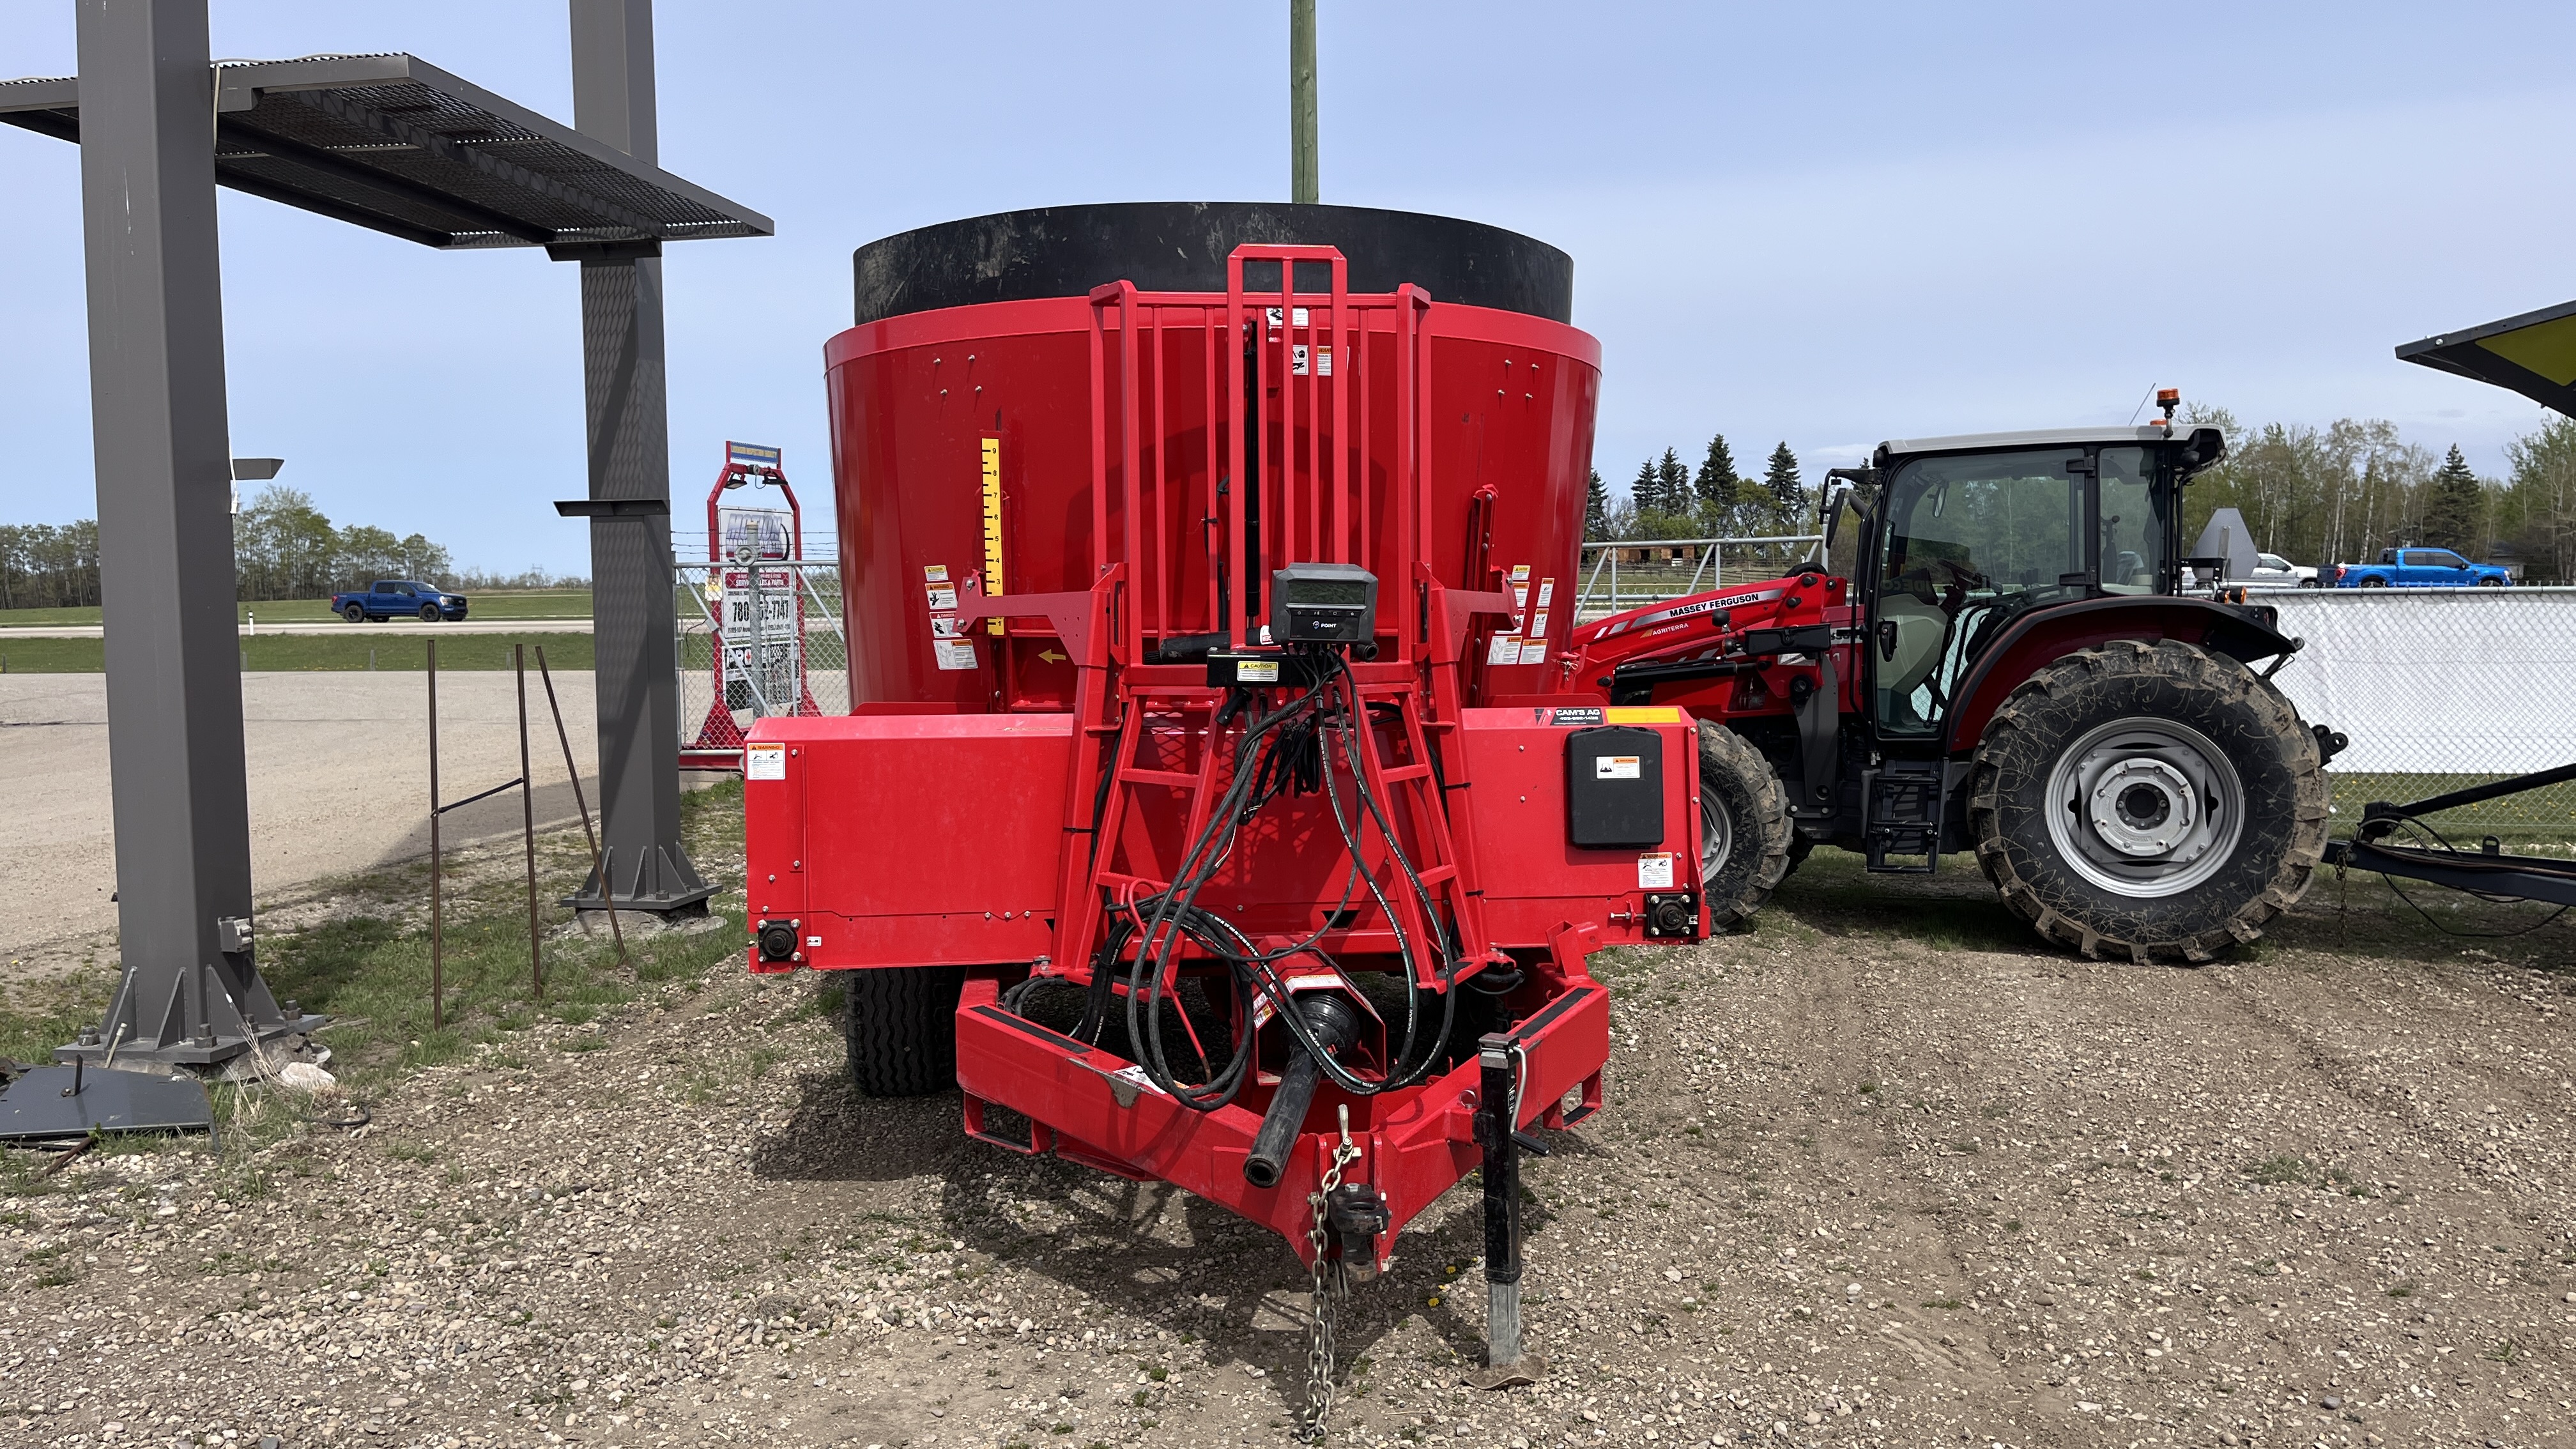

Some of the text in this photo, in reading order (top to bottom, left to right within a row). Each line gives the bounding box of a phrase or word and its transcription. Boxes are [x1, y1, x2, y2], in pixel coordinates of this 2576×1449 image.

[1669, 593, 1759, 617] MASSEY FERGUSON
[1652, 622, 1689, 636] AGRITERRA
